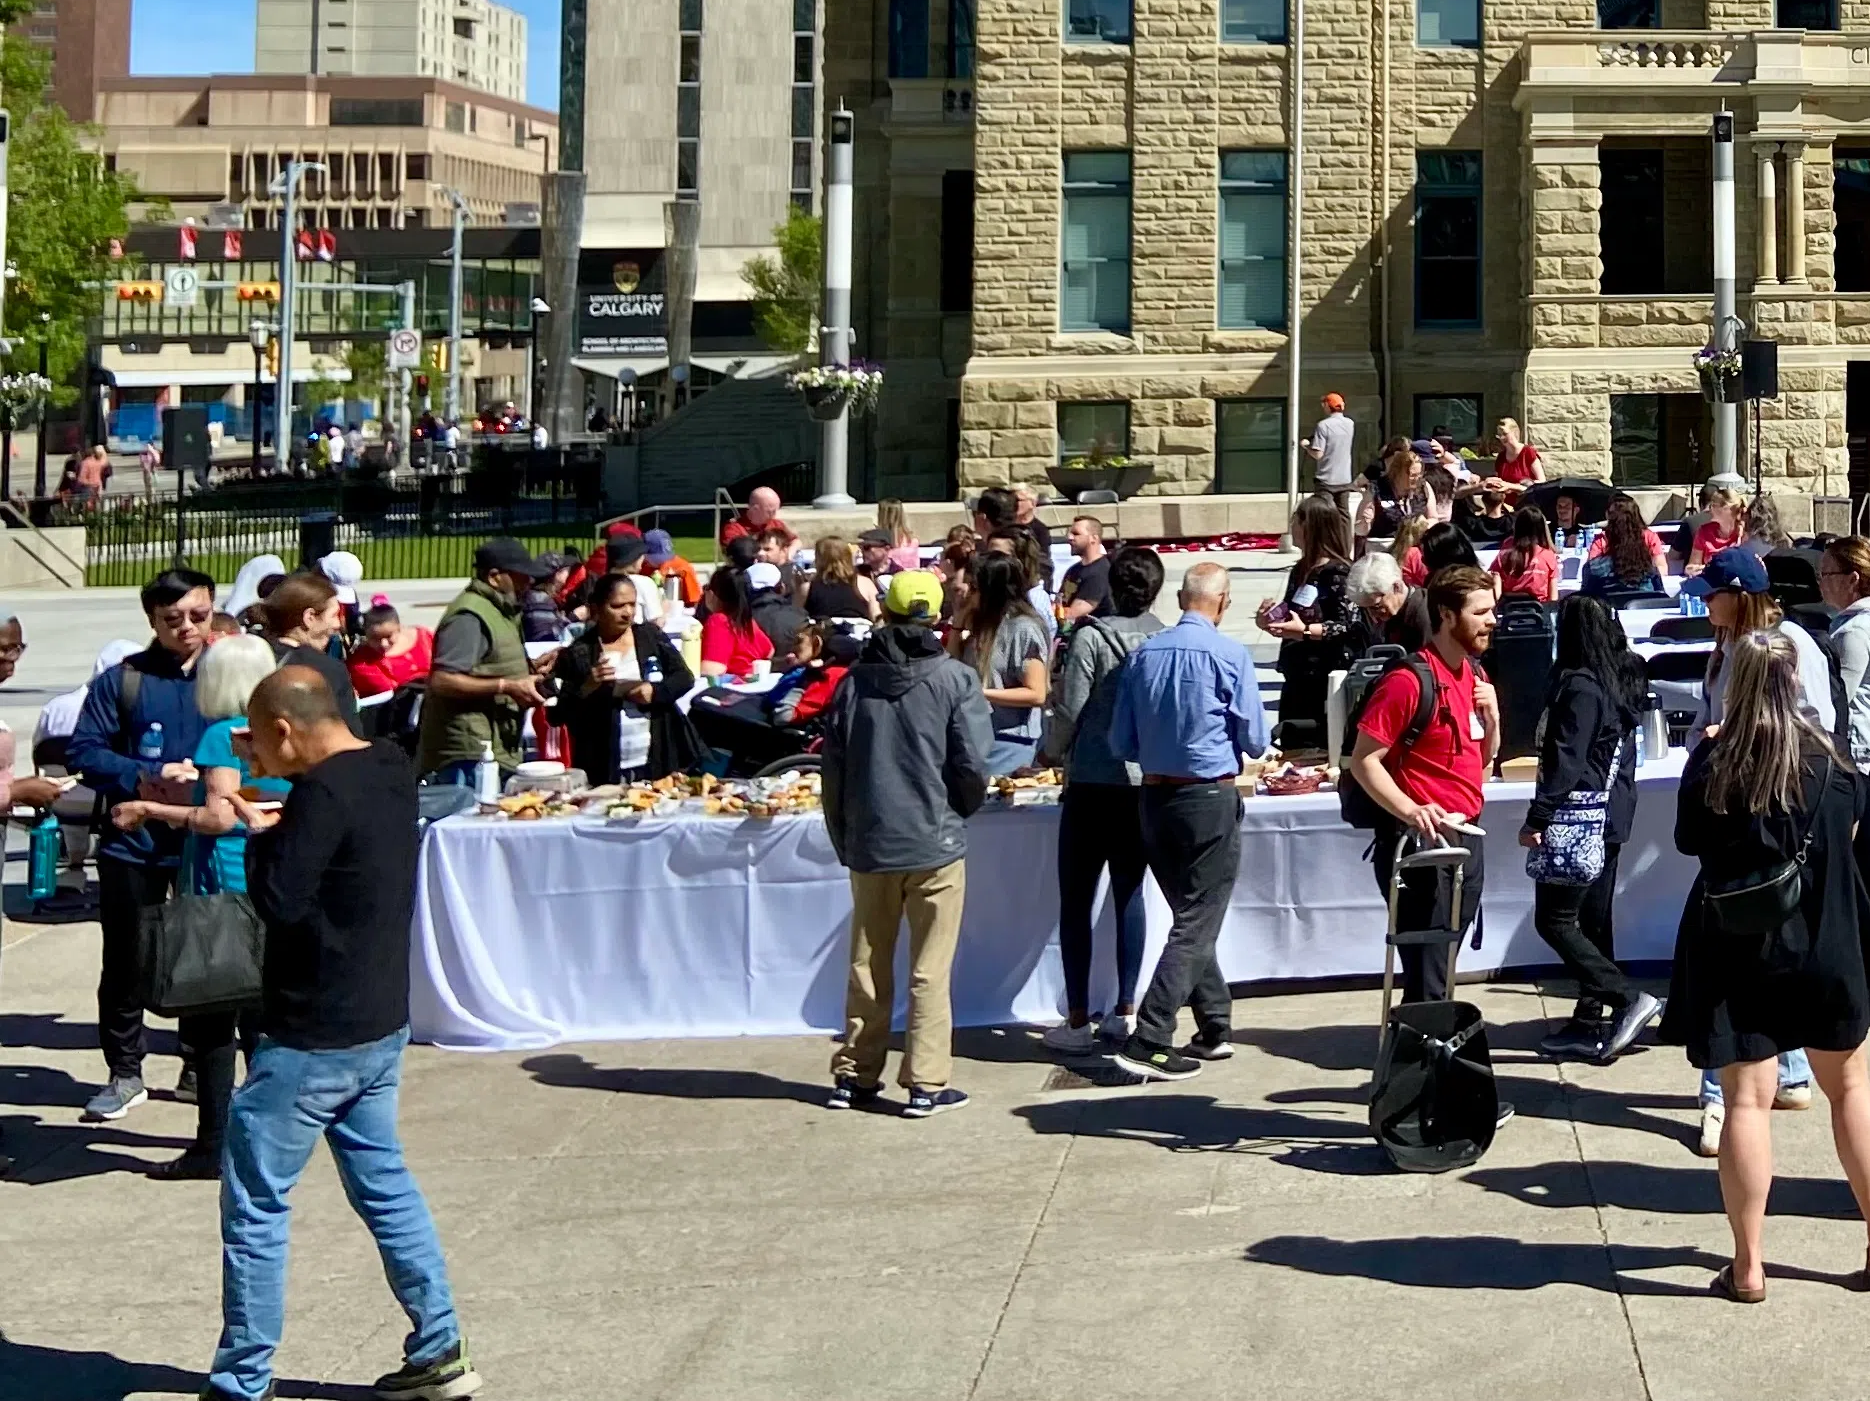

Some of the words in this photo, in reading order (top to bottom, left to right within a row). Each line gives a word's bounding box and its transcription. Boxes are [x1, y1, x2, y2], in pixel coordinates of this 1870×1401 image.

[589, 294, 647, 303] UNIVERSITY
[650, 294, 664, 302] OF
[588, 302, 664, 317] CALGARY
